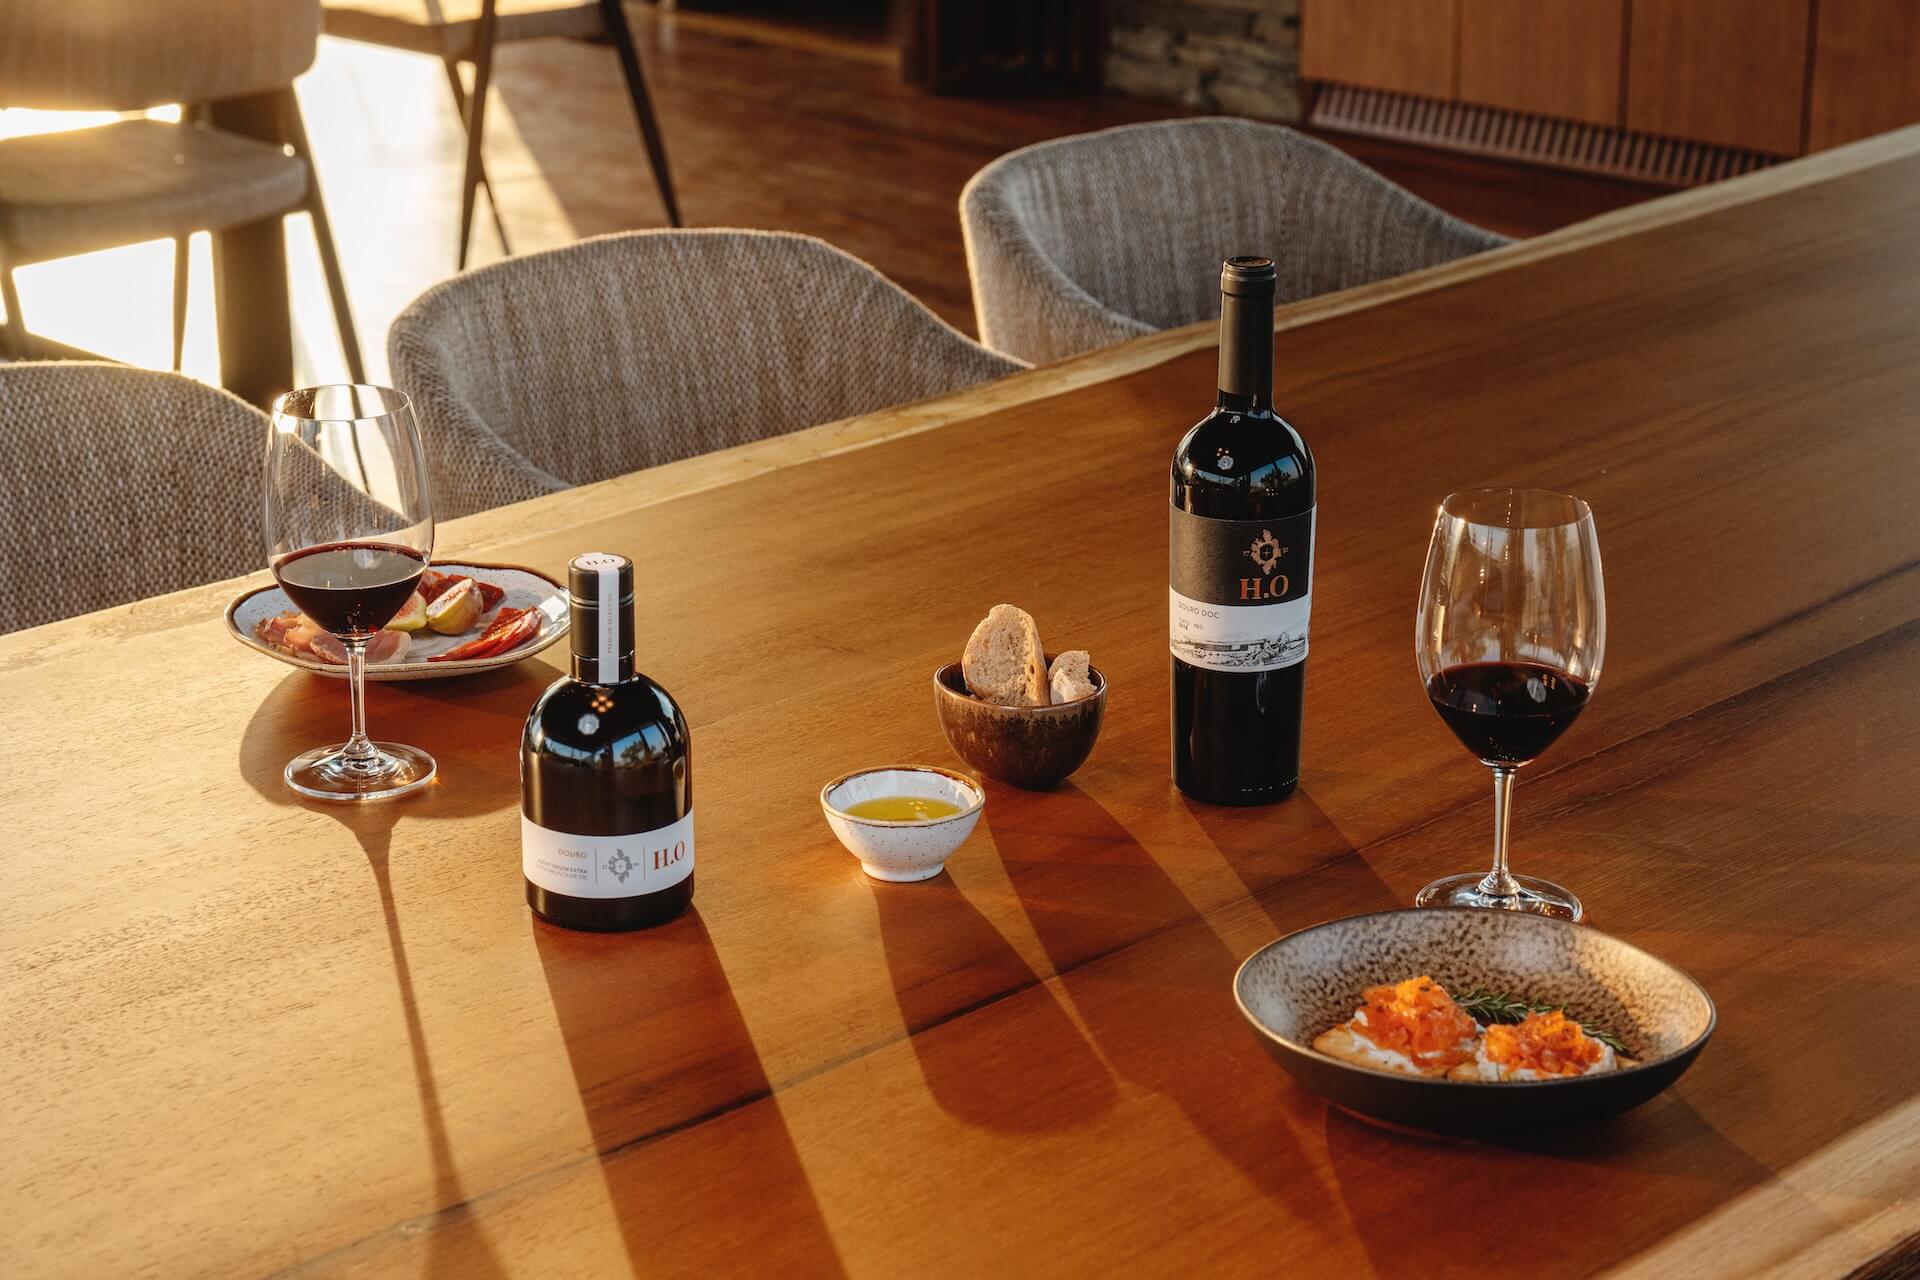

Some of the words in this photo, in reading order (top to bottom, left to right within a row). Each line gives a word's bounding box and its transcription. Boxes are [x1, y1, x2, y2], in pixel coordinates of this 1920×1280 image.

[1239, 574, 1289, 600] H.O
[1178, 600, 1199, 615] DOURO
[1201, 609, 1220, 619] DOC
[558, 848, 588, 859] DOURO
[654, 840, 686, 870] H.O
